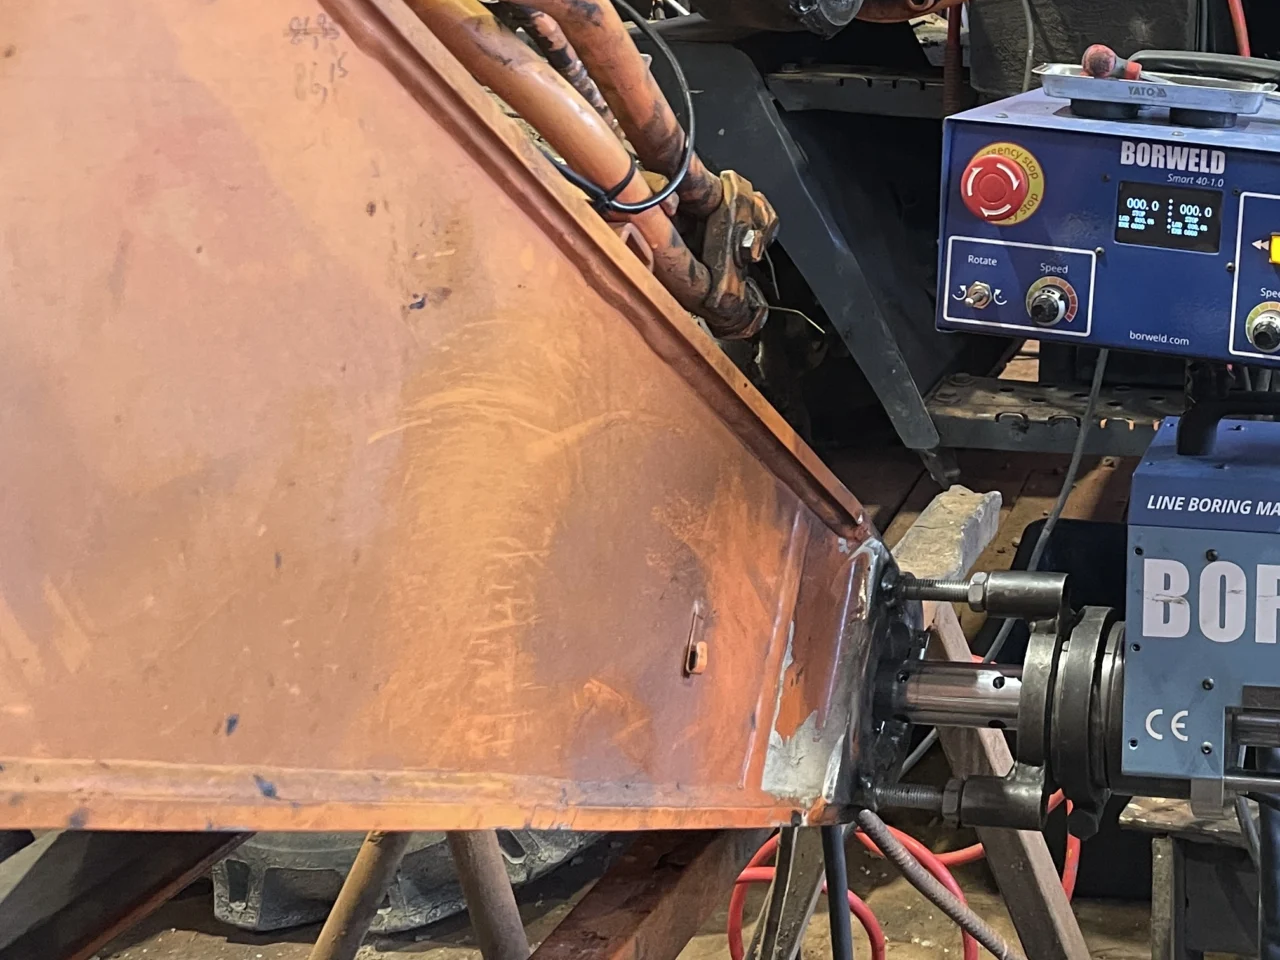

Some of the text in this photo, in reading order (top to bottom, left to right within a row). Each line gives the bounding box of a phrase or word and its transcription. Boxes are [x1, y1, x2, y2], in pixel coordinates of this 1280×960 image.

[1128, 86, 1155, 97] YATO
[1120, 141, 1226, 175] BORWELD
[1021, 156, 1039, 180] stop
[1166, 173, 1224, 187] Smart 40-1.0
[1020, 193, 1039, 215] stop
[967, 254, 998, 266] Rotate
[1040, 263, 1069, 274] Speed
[1129, 330, 1190, 345] borweld.com
[1146, 494, 1185, 511] LINE
[1187, 496, 1252, 515] BORING
[1145, 708, 1189, 742] CE
